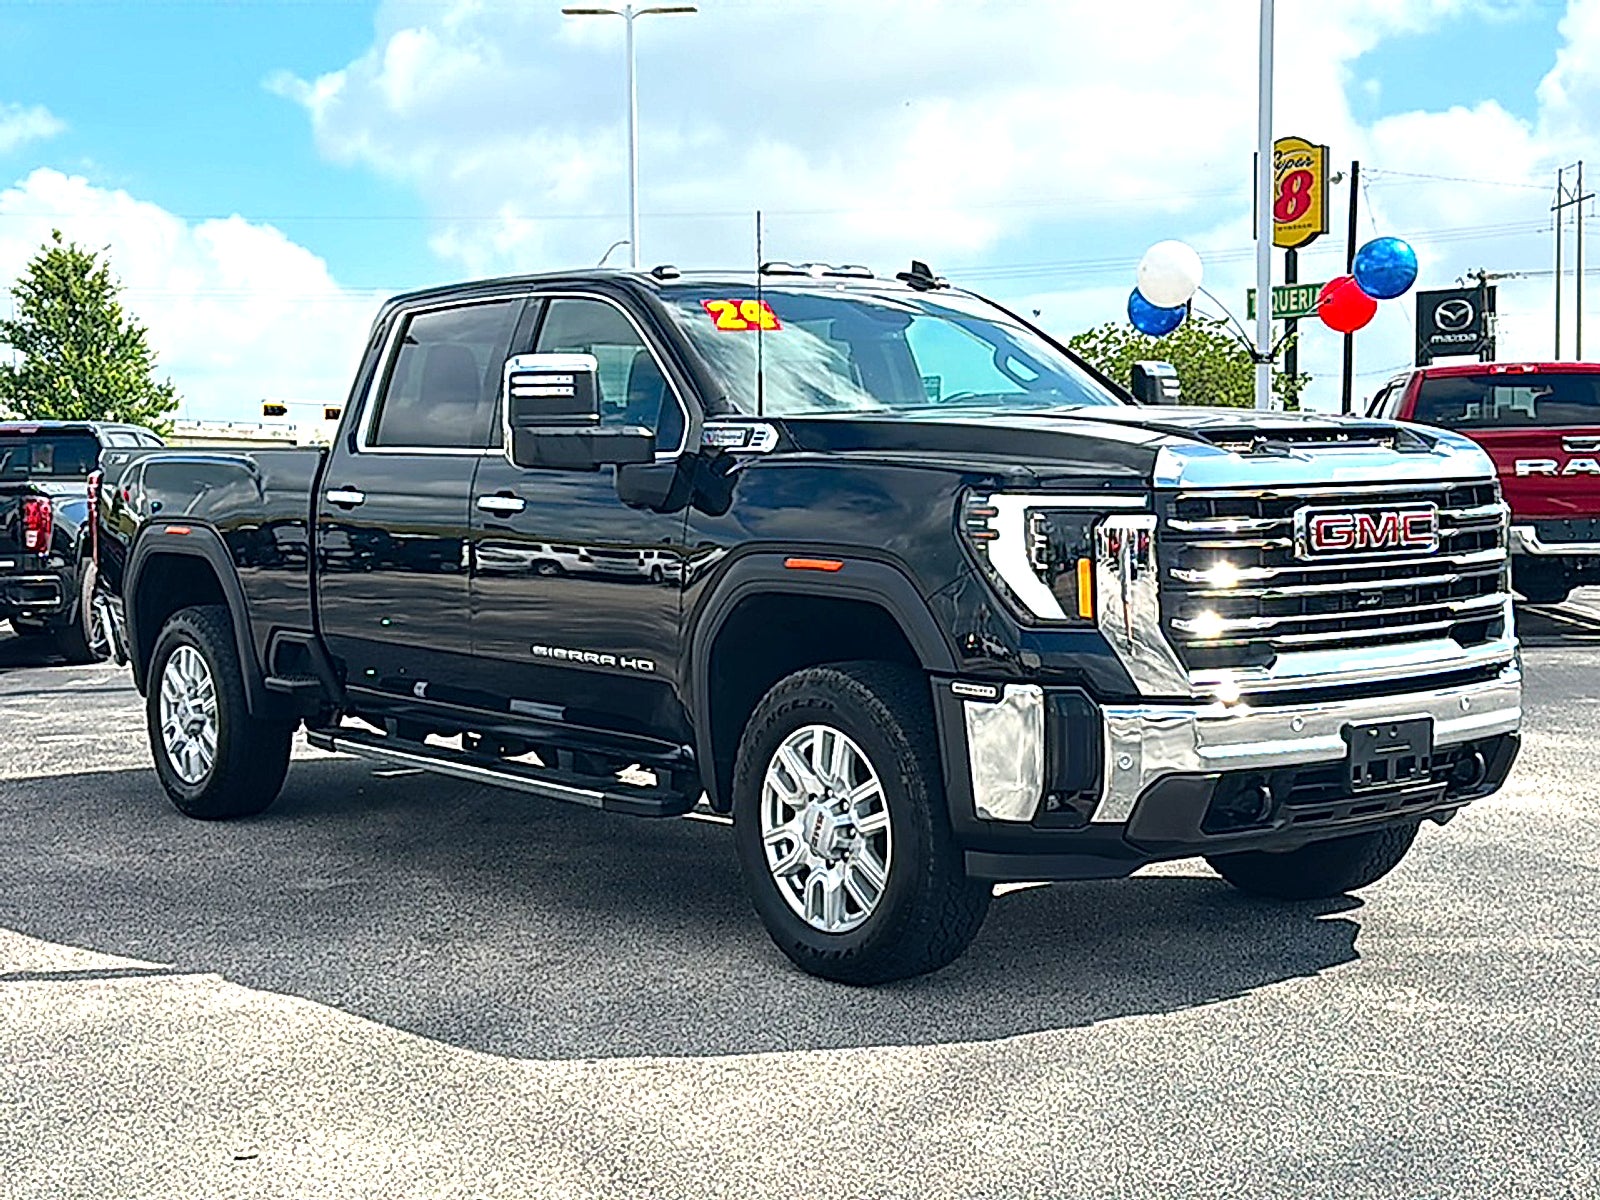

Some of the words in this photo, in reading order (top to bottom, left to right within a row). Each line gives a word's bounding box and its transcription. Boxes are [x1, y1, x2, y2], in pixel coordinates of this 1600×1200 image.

[1273, 169, 1314, 222] 8
[1309, 511, 1435, 551] GMC
[532, 645, 616, 666] SIERRA
[620, 656, 655, 672] HD
